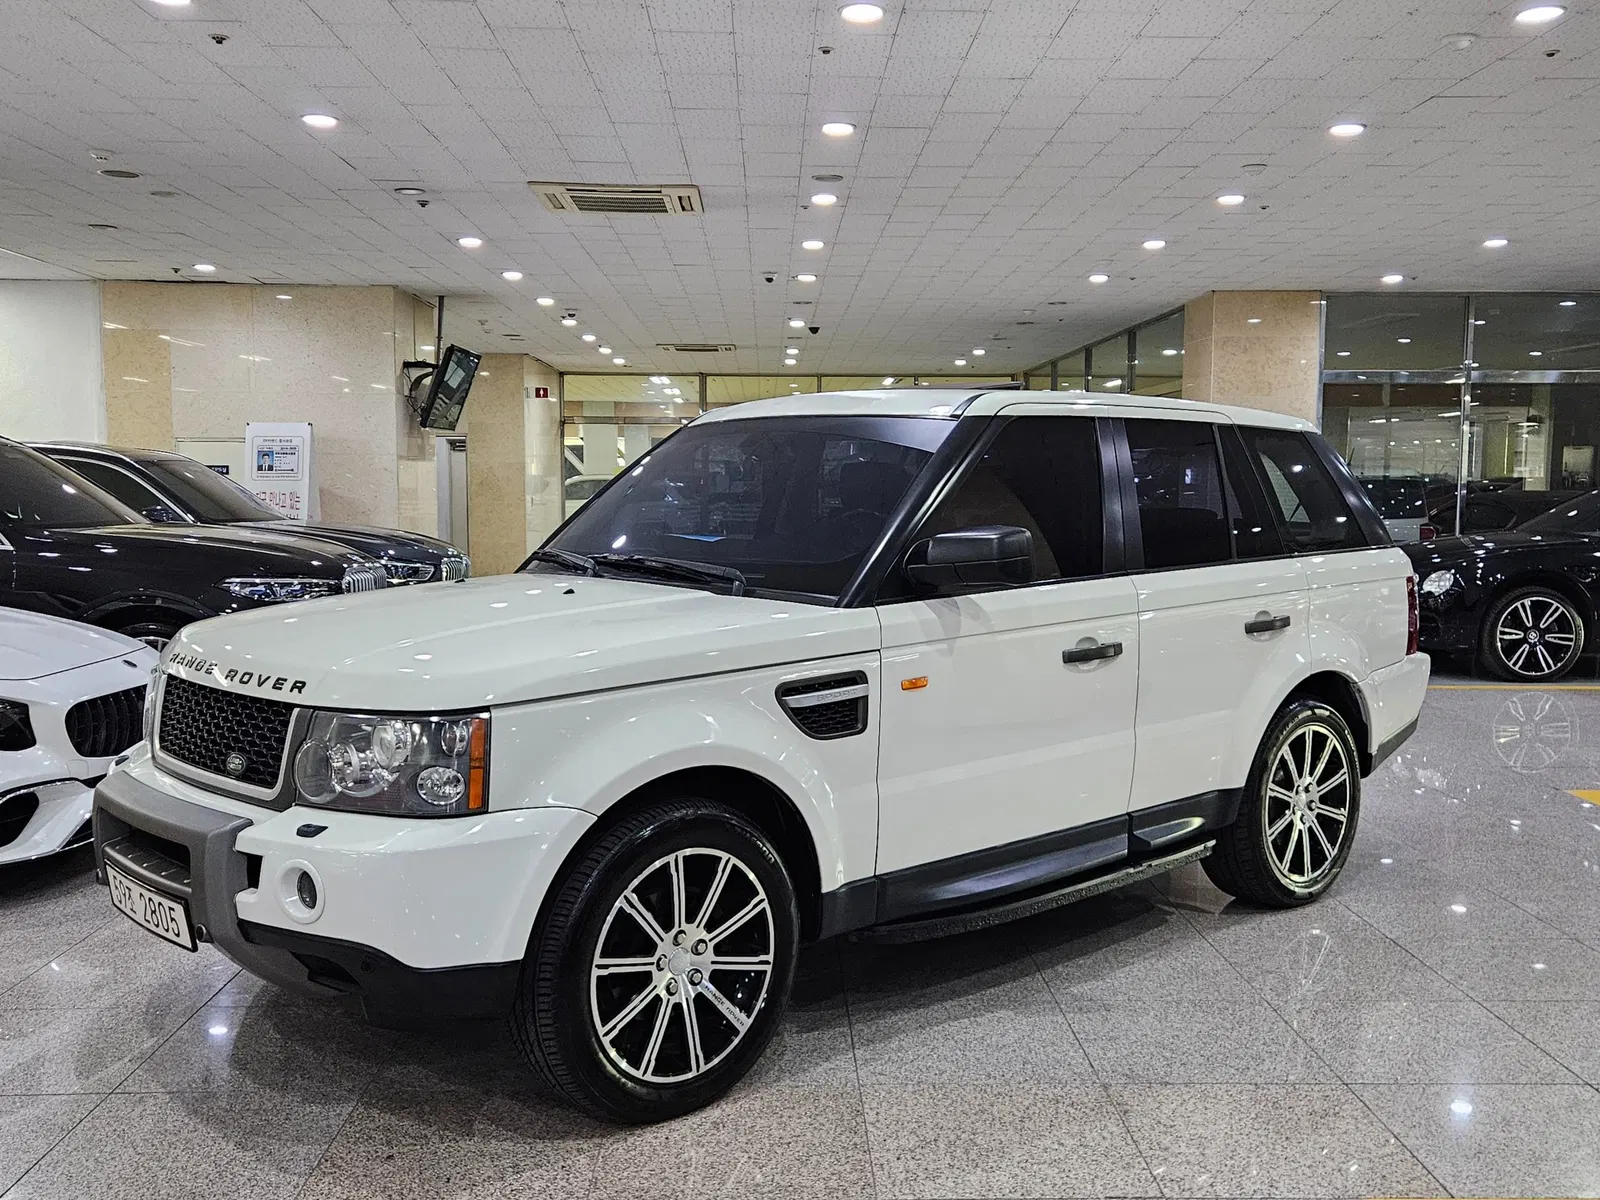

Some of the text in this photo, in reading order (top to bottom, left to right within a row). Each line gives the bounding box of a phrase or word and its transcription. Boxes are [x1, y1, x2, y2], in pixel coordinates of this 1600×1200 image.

[169, 652, 307, 694] RANGE ROVER
[139, 892, 180, 938] 2805
